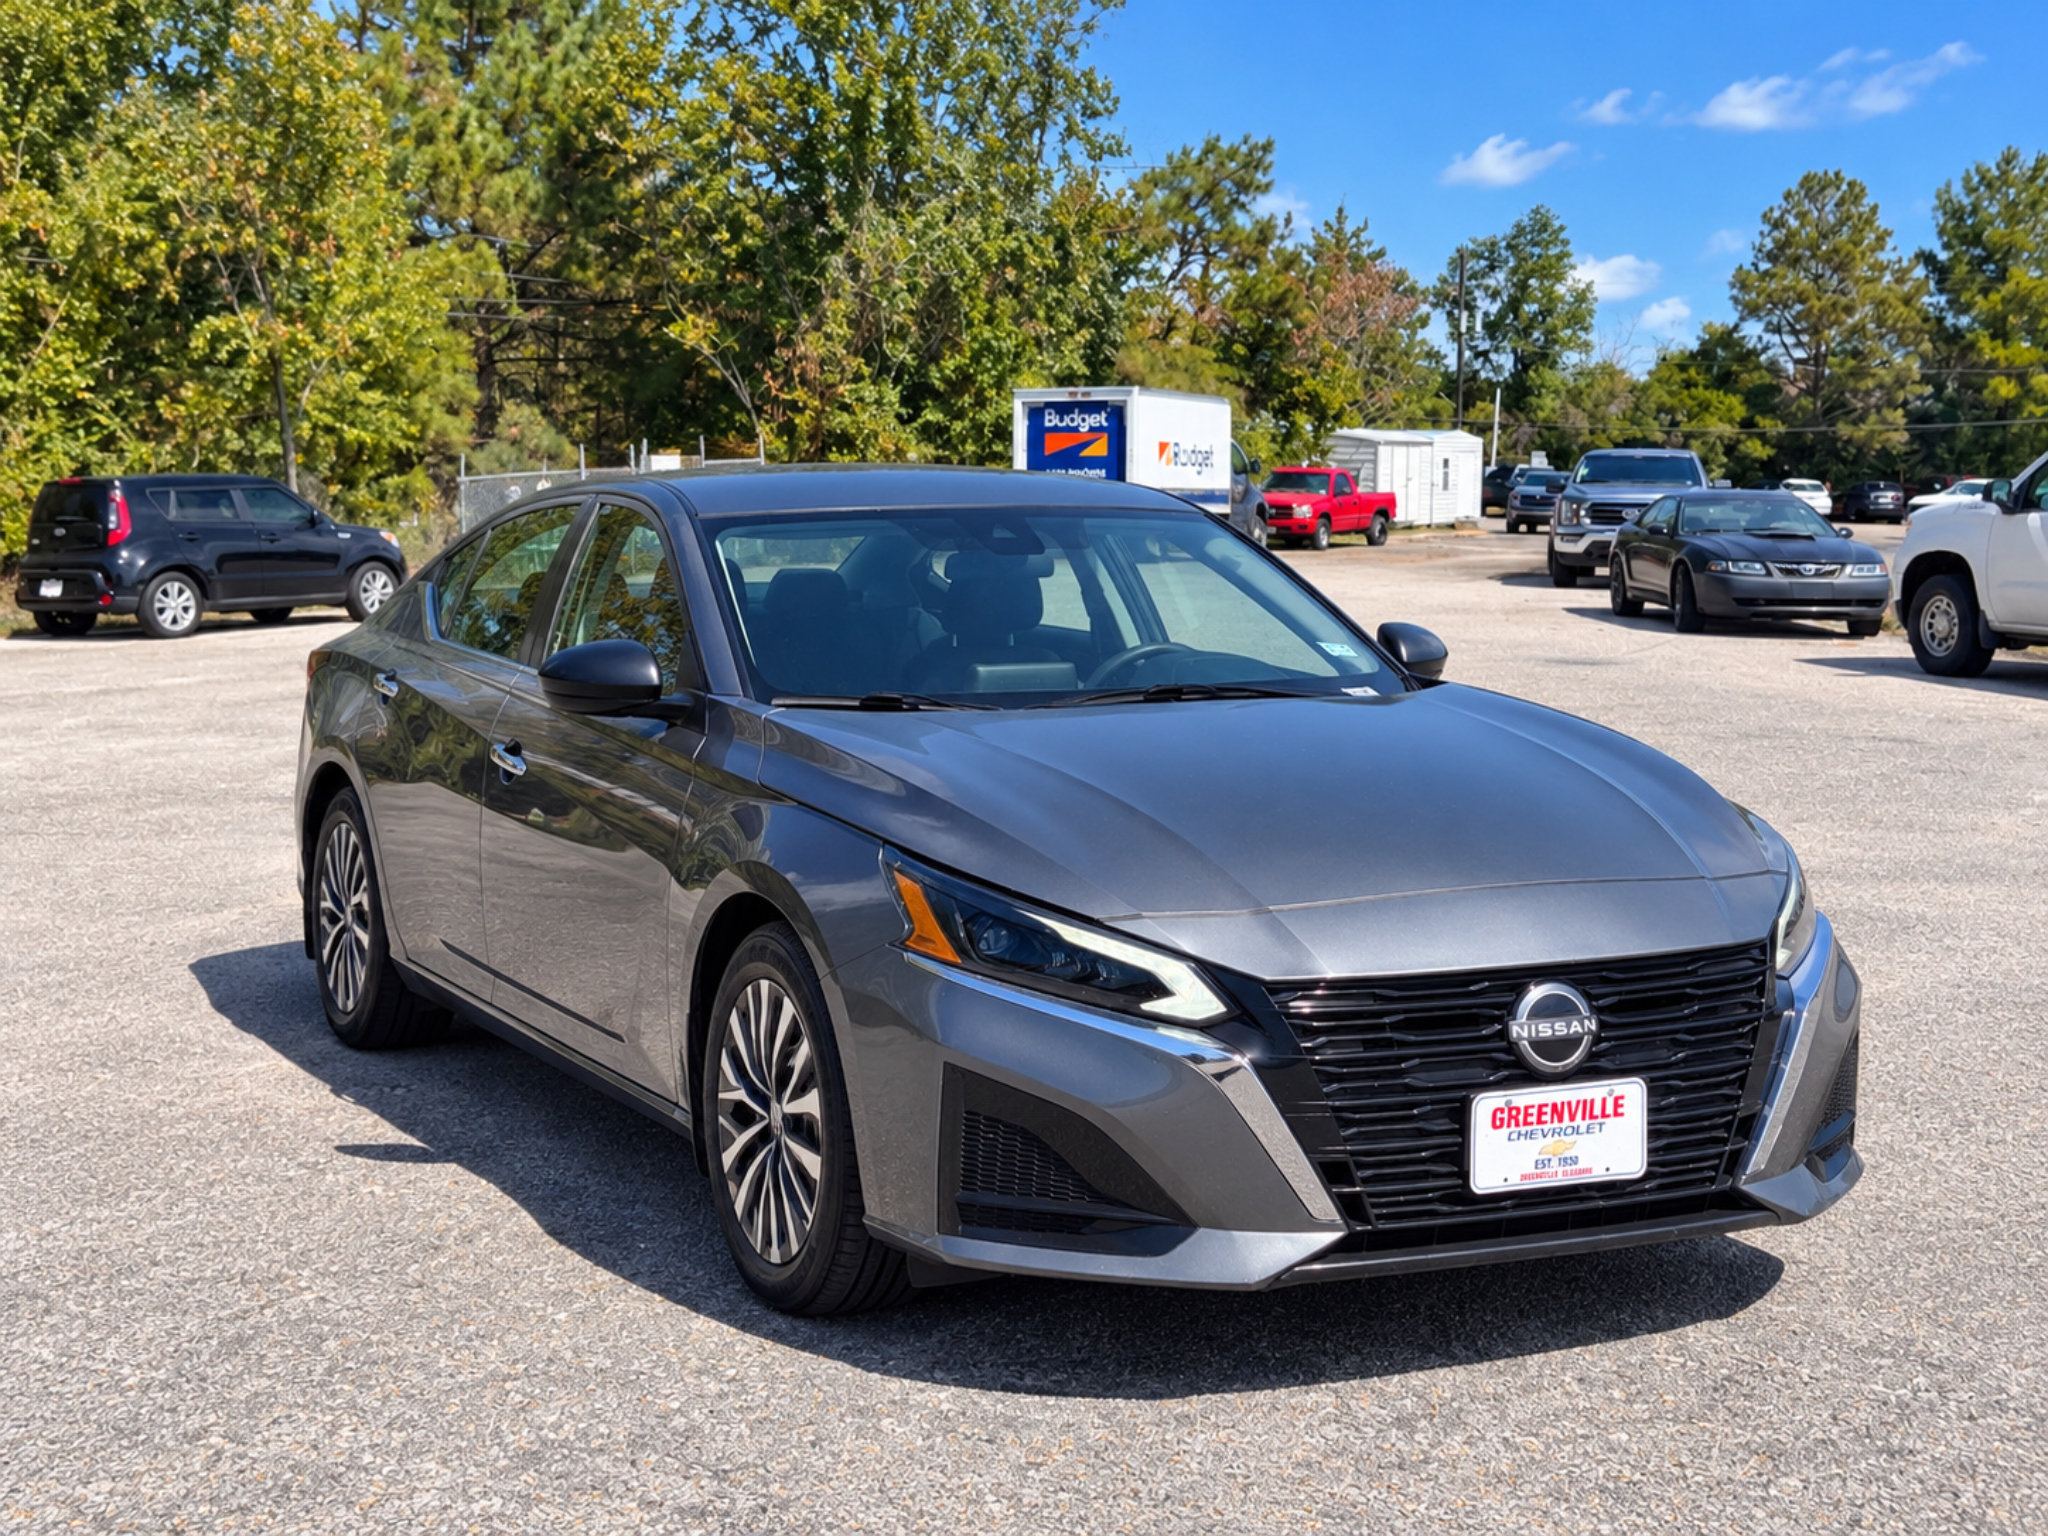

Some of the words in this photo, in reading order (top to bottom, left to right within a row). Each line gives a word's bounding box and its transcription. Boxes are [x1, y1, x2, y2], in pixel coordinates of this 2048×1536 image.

[1044, 408, 1109, 432] Budget
[1512, 1018, 1597, 1038] NISSAN
[1491, 1095, 1626, 1130] GREENVILLE
[1507, 1122, 1606, 1142] CHEVROLET
[1534, 1158, 1554, 1170] EST.
